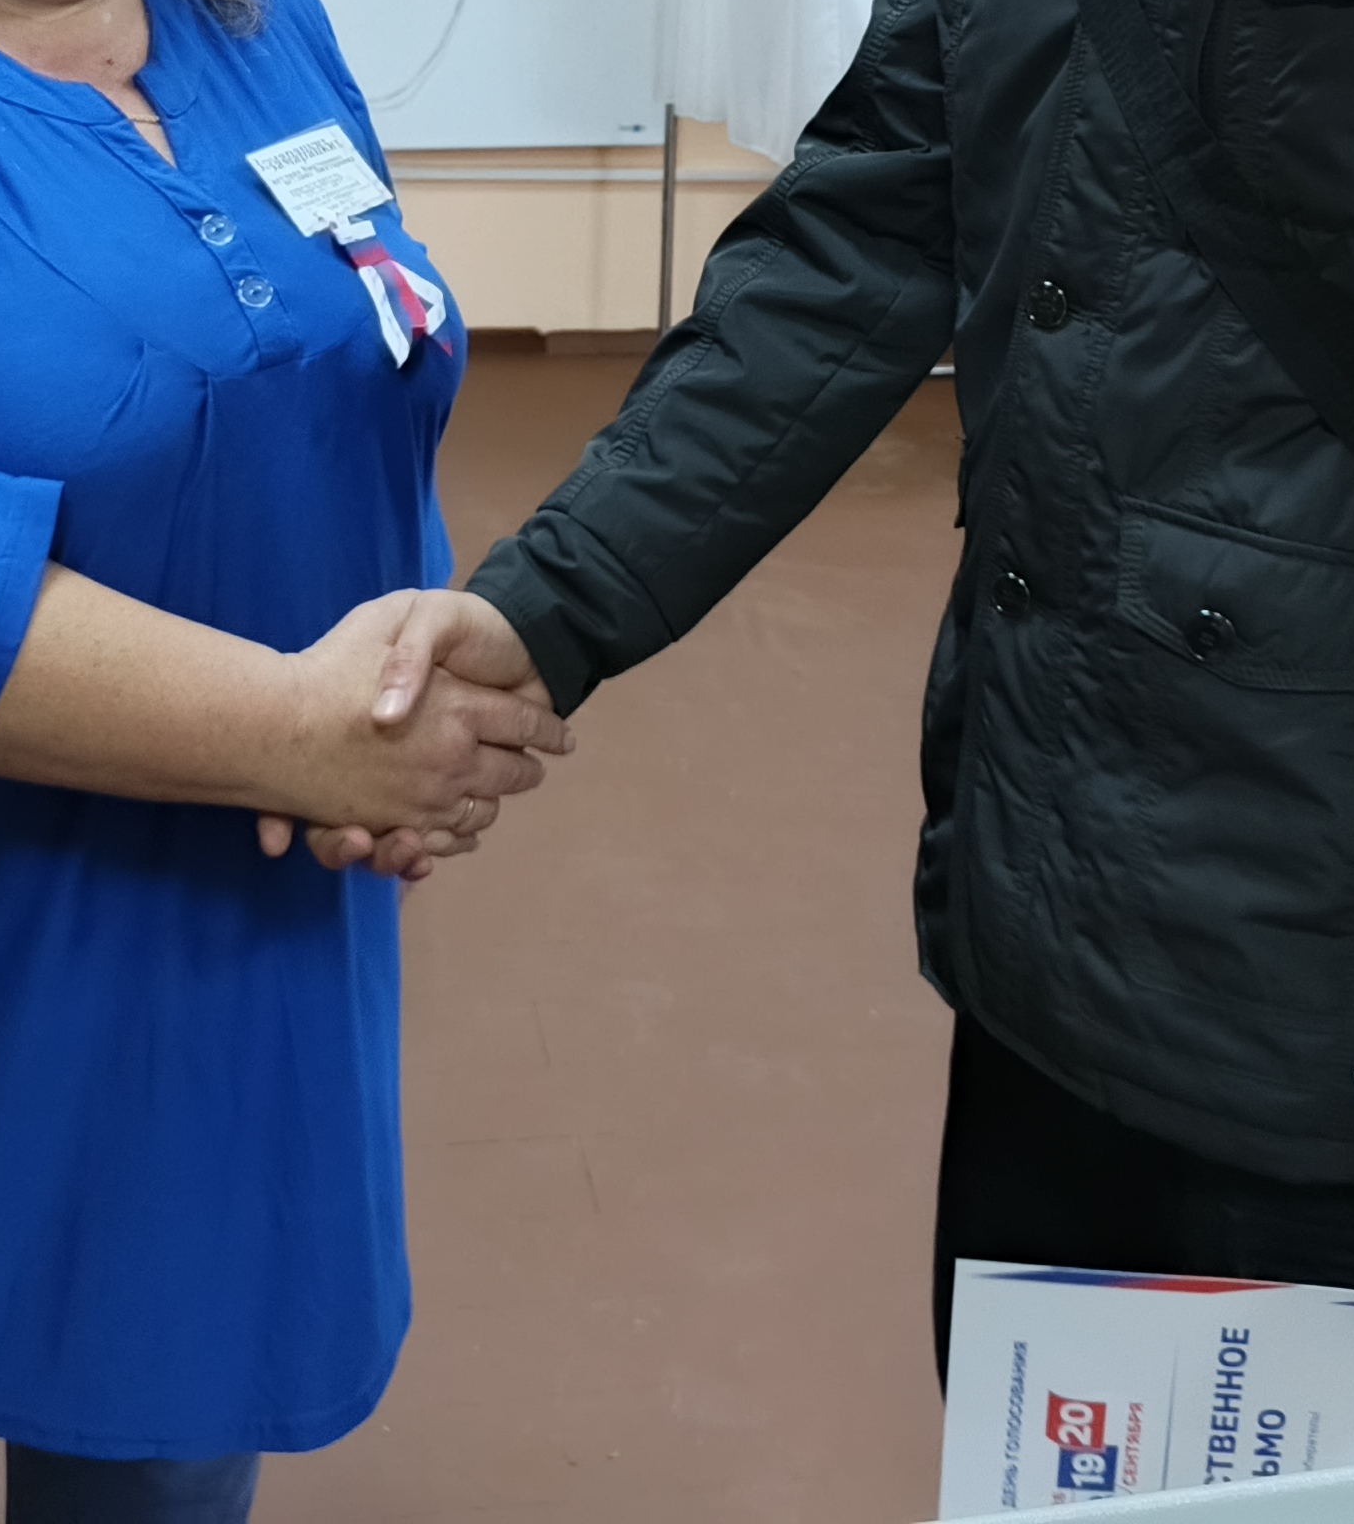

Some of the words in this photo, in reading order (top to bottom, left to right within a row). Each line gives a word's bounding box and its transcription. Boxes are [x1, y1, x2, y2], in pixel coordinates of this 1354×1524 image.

[1004, 1340, 1028, 1461] ГОЛОСОВАНИЯ
[1057, 1402, 1094, 1446] 20
[1122, 1402, 1144, 1487] СЕНТЯБРЯ
[1002, 1462, 1019, 1508] ДЕНЬ
[1070, 1452, 1107, 1488] 19
